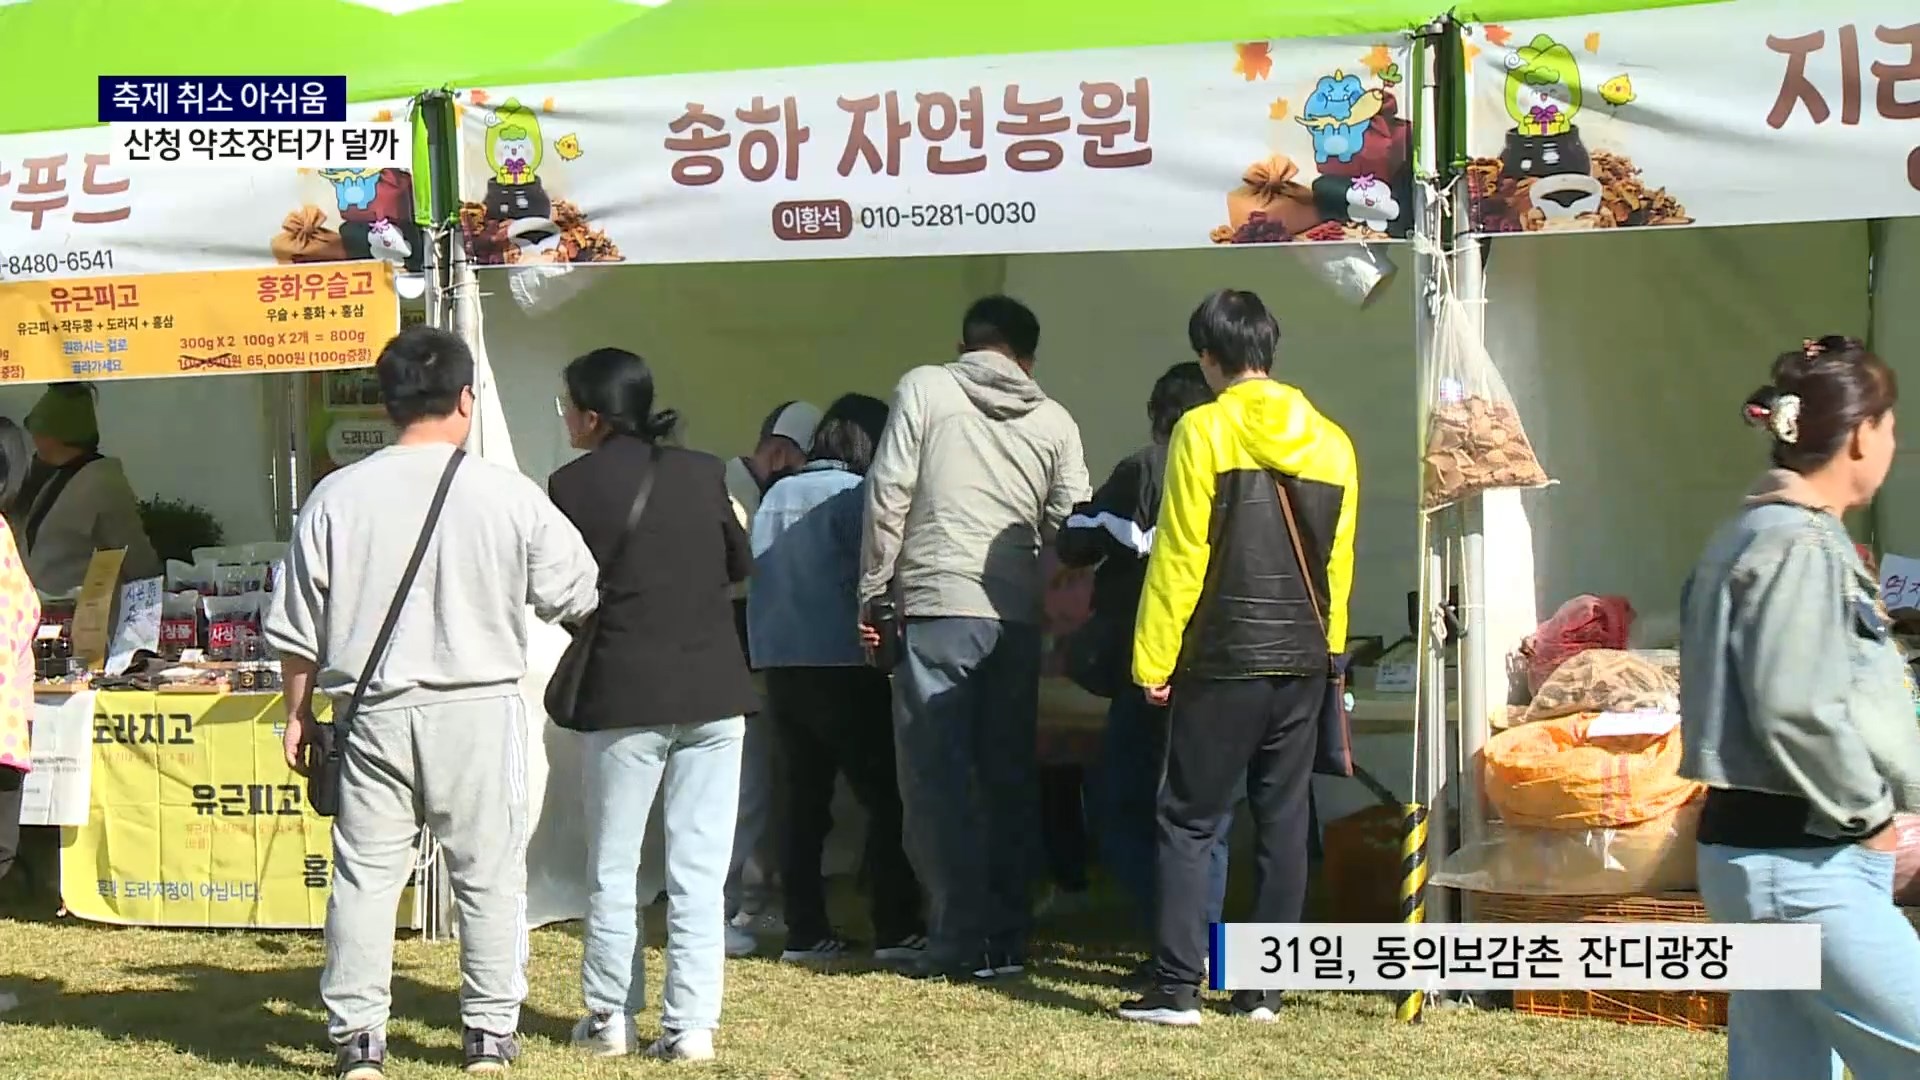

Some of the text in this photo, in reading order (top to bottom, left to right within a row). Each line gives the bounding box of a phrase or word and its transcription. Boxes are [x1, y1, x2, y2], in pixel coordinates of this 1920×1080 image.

[664, 77, 1152, 186] 송하 자연농원
[0, 153, 131, 230] 푸드
[782, 207, 841, 235] 이황석
[860, 202, 1037, 229] 010-5281-0030
[0, 249, 113, 275] -8480-6541
[51, 283, 139, 313] 유근피고
[257, 271, 374, 303] 홍화우슬고
[107, 317, 138, 331] 도라지
[330, 330, 365, 343] 800g
[247, 352, 305, 369] 65,000원
[190, 784, 303, 816] 유근피고
